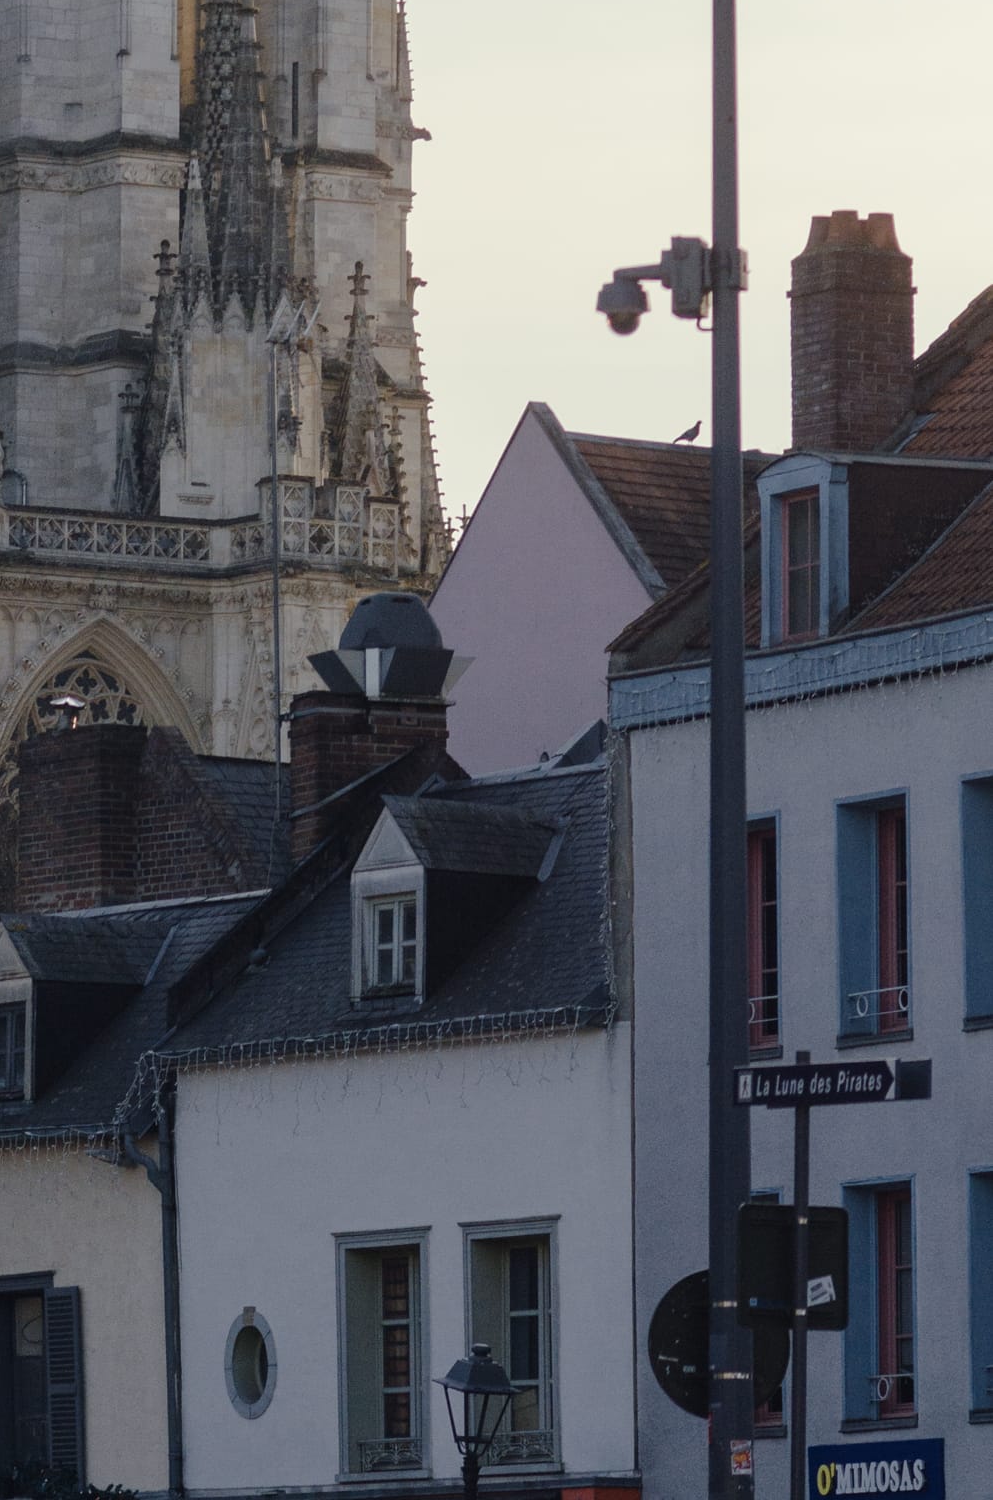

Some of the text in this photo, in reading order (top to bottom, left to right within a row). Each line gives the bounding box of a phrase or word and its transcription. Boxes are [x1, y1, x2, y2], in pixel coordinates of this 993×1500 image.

[755, 1070, 882, 1097] La Lune des Pirates
[816, 1458, 926, 1496] O'MIMOSAS
